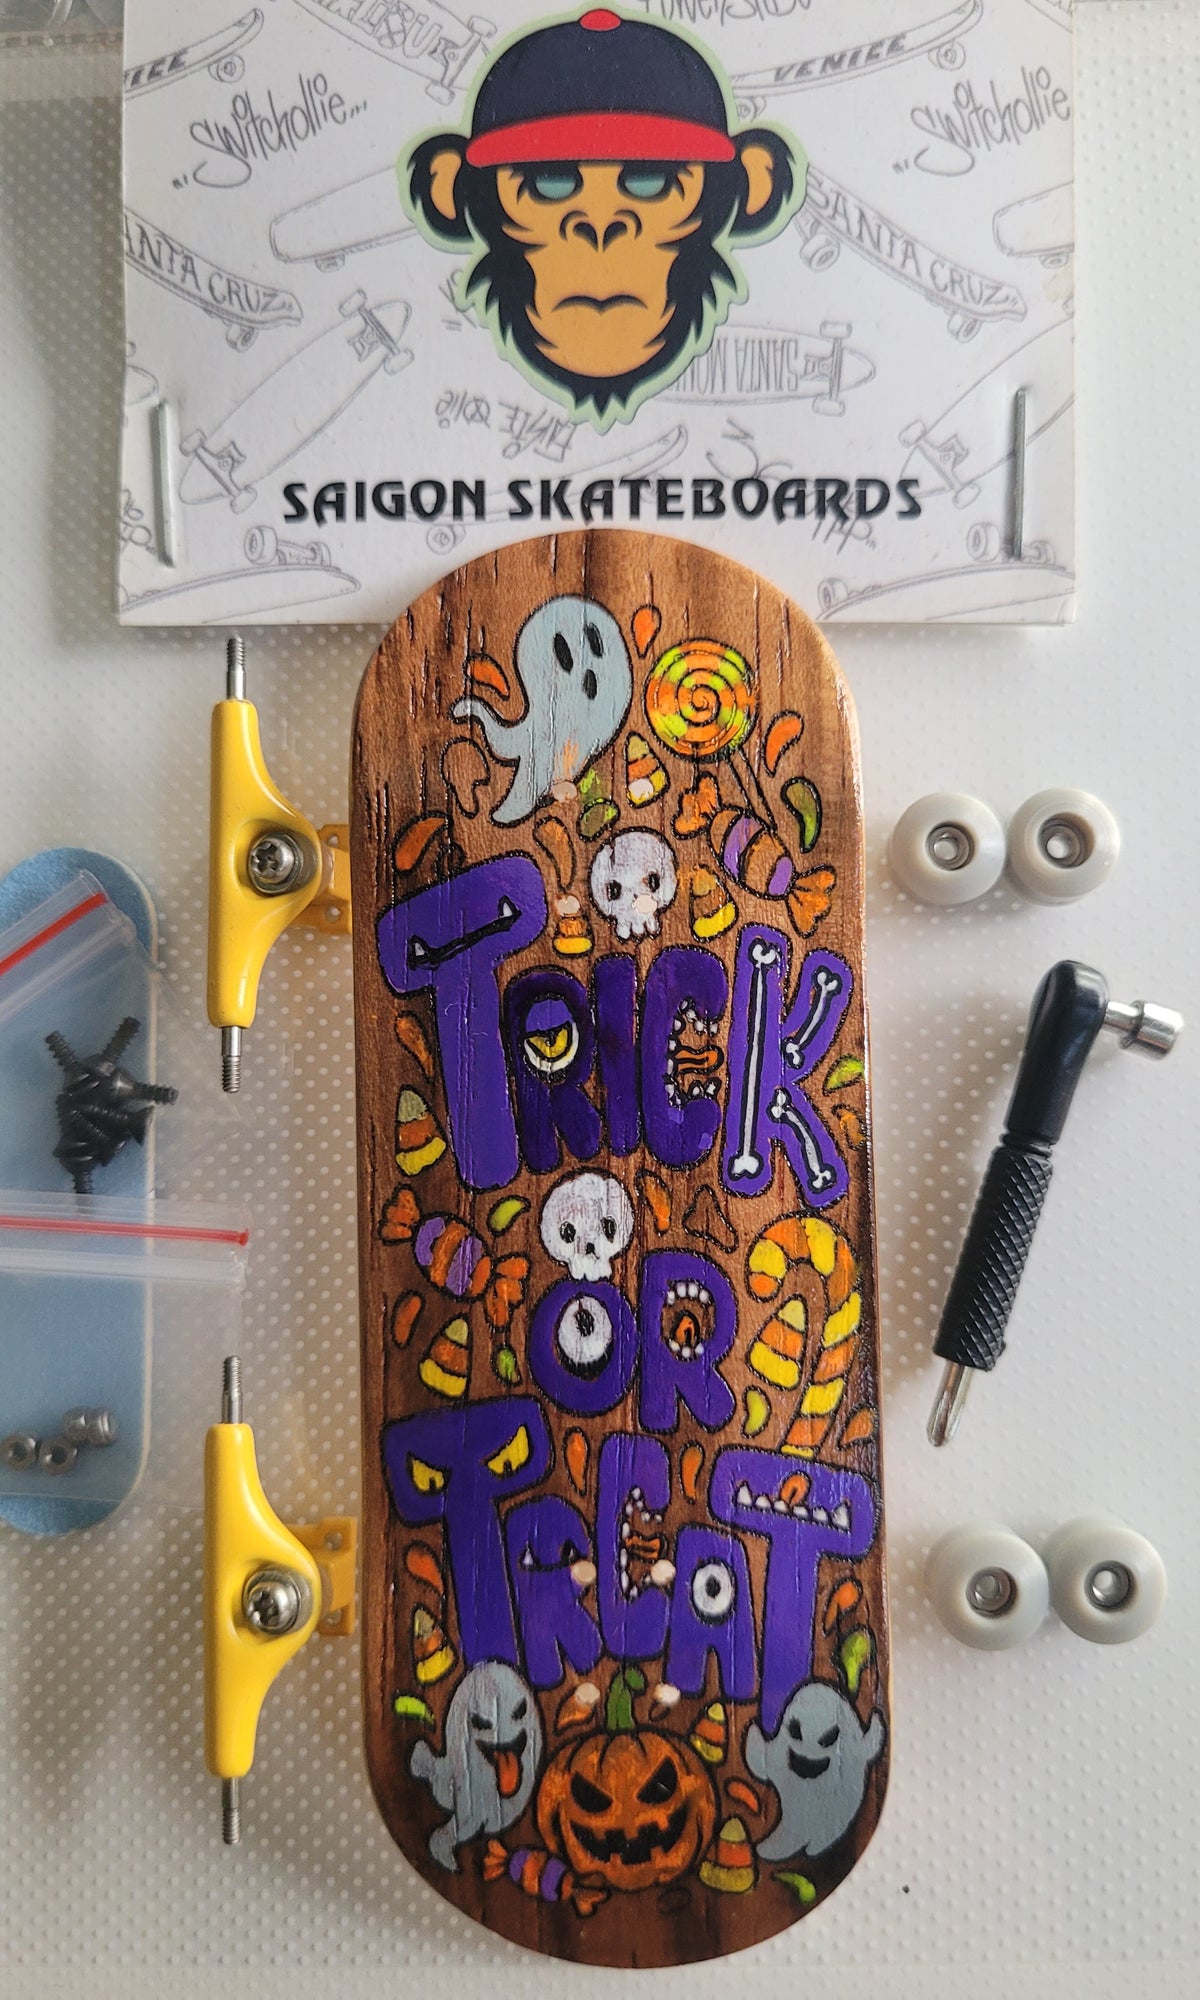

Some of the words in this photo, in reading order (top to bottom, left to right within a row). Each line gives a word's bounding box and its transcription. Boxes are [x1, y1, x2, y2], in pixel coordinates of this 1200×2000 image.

[124, 49, 188, 88] ICE
[774, 31, 906, 83] VENICE
[806, 168, 922, 279] SANTA
[929, 258, 1010, 307] CRUZ
[208, 271, 288, 315] CRUZ
[283, 478, 487, 527] SAIGON
[507, 477, 923, 526] SKATEBOARDS
[376, 849, 854, 1210] TRICK
[529, 1247, 740, 1434] OR
[380, 1393, 881, 1737] TREAT
